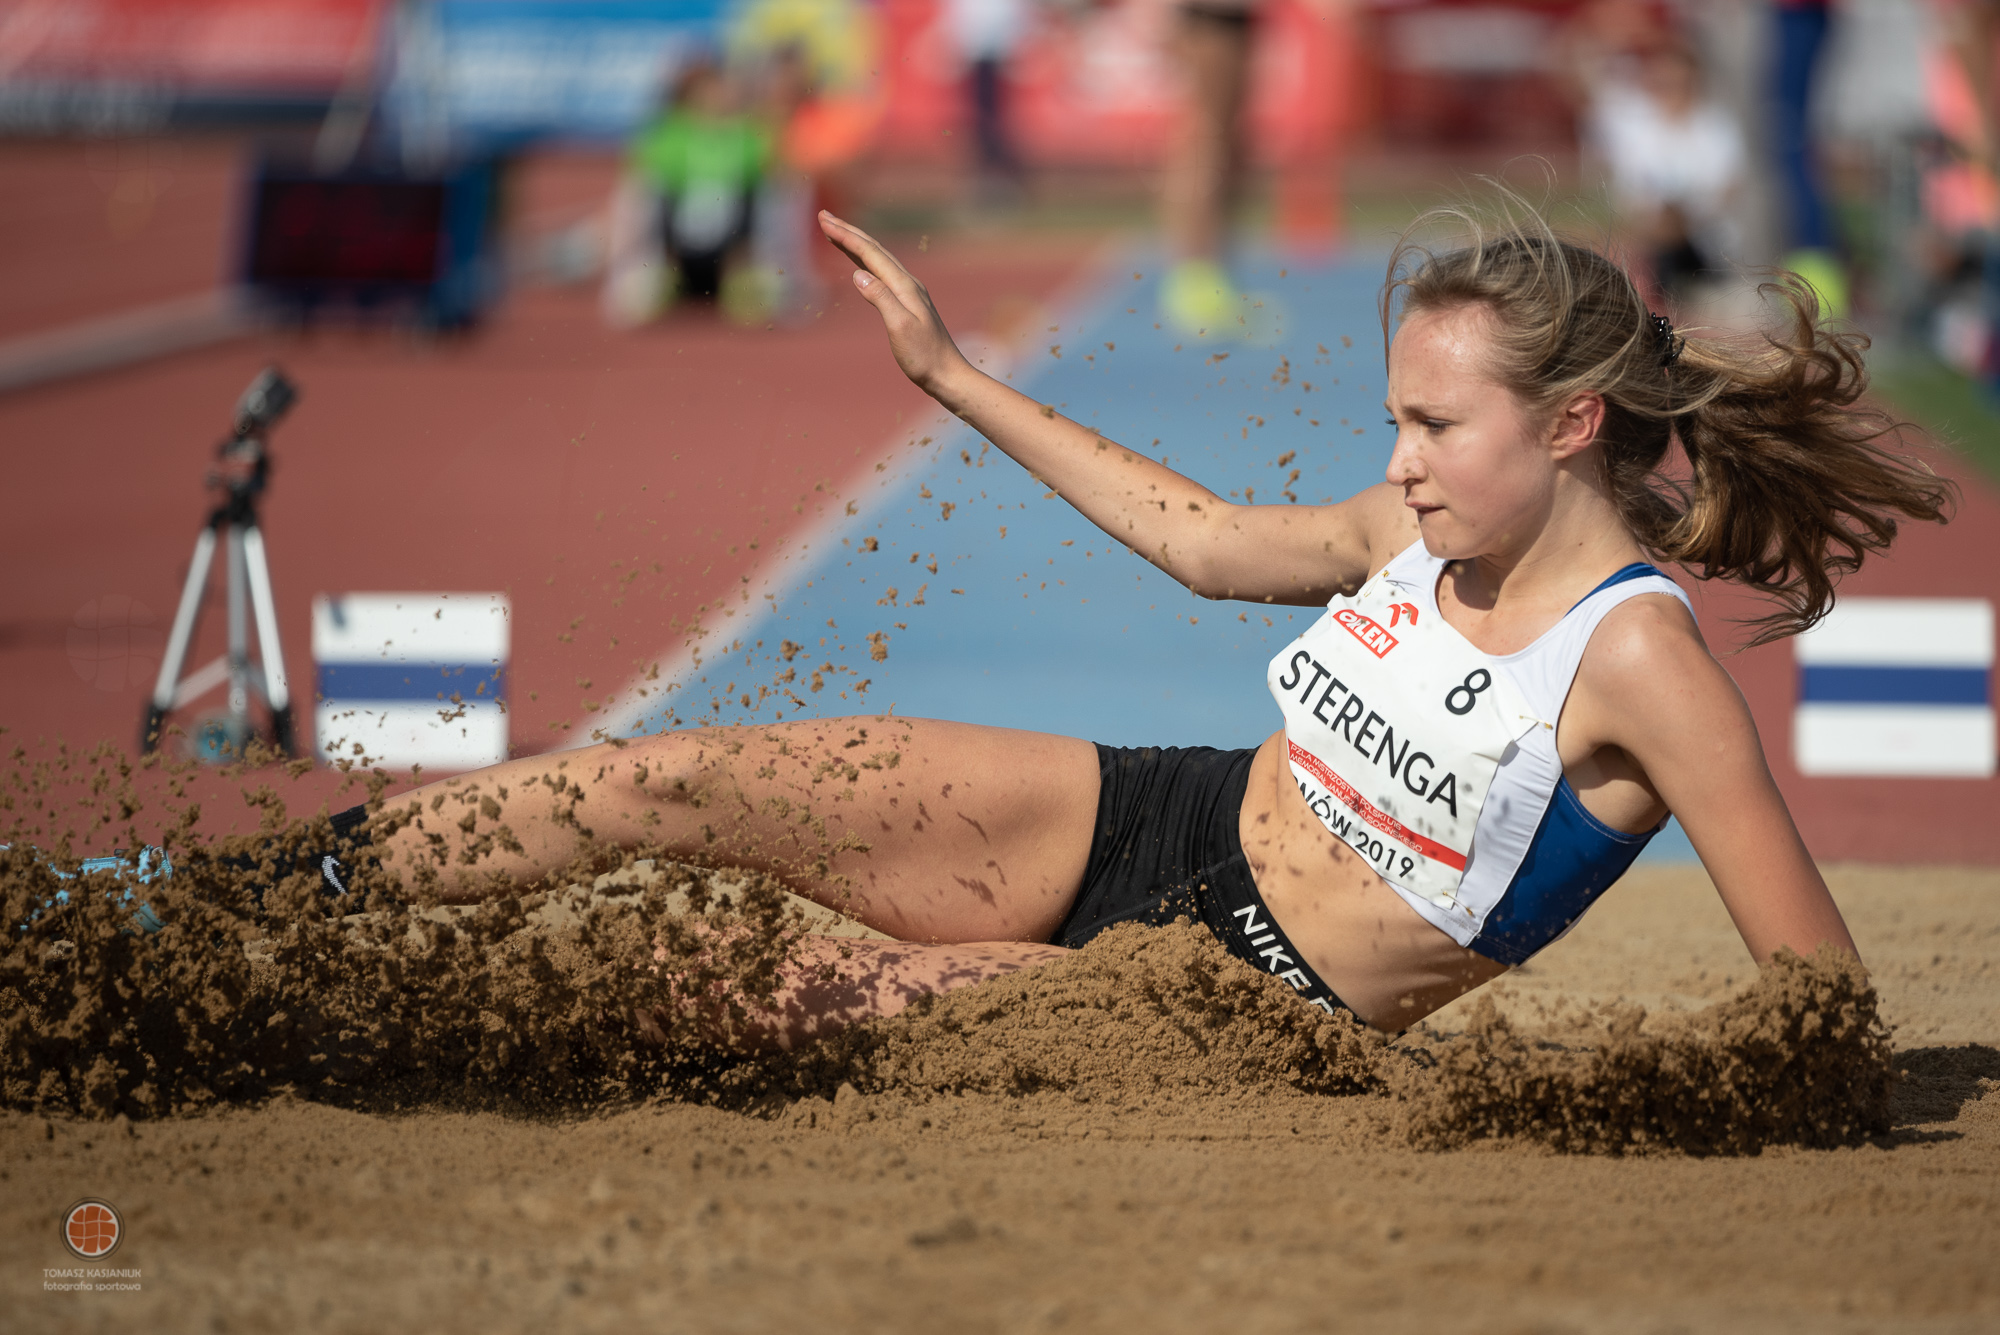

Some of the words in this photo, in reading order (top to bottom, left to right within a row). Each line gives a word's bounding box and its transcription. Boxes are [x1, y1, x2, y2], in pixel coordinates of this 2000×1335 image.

[1338, 610, 1394, 655] ORLEN
[1445, 668, 1491, 715] 8
[1279, 650, 1457, 818] STERENGA
[1290, 743, 1312, 761] PZLA
[1312, 758, 1360, 801] MISTRZOSTWA
[1360, 798, 1387, 821] POLSKI
[1326, 783, 1359, 812] JANUSZA
[1293, 774, 1352, 837] NÓW
[1355, 831, 1414, 878] 2019
[1232, 904, 1312, 990] NIKE
